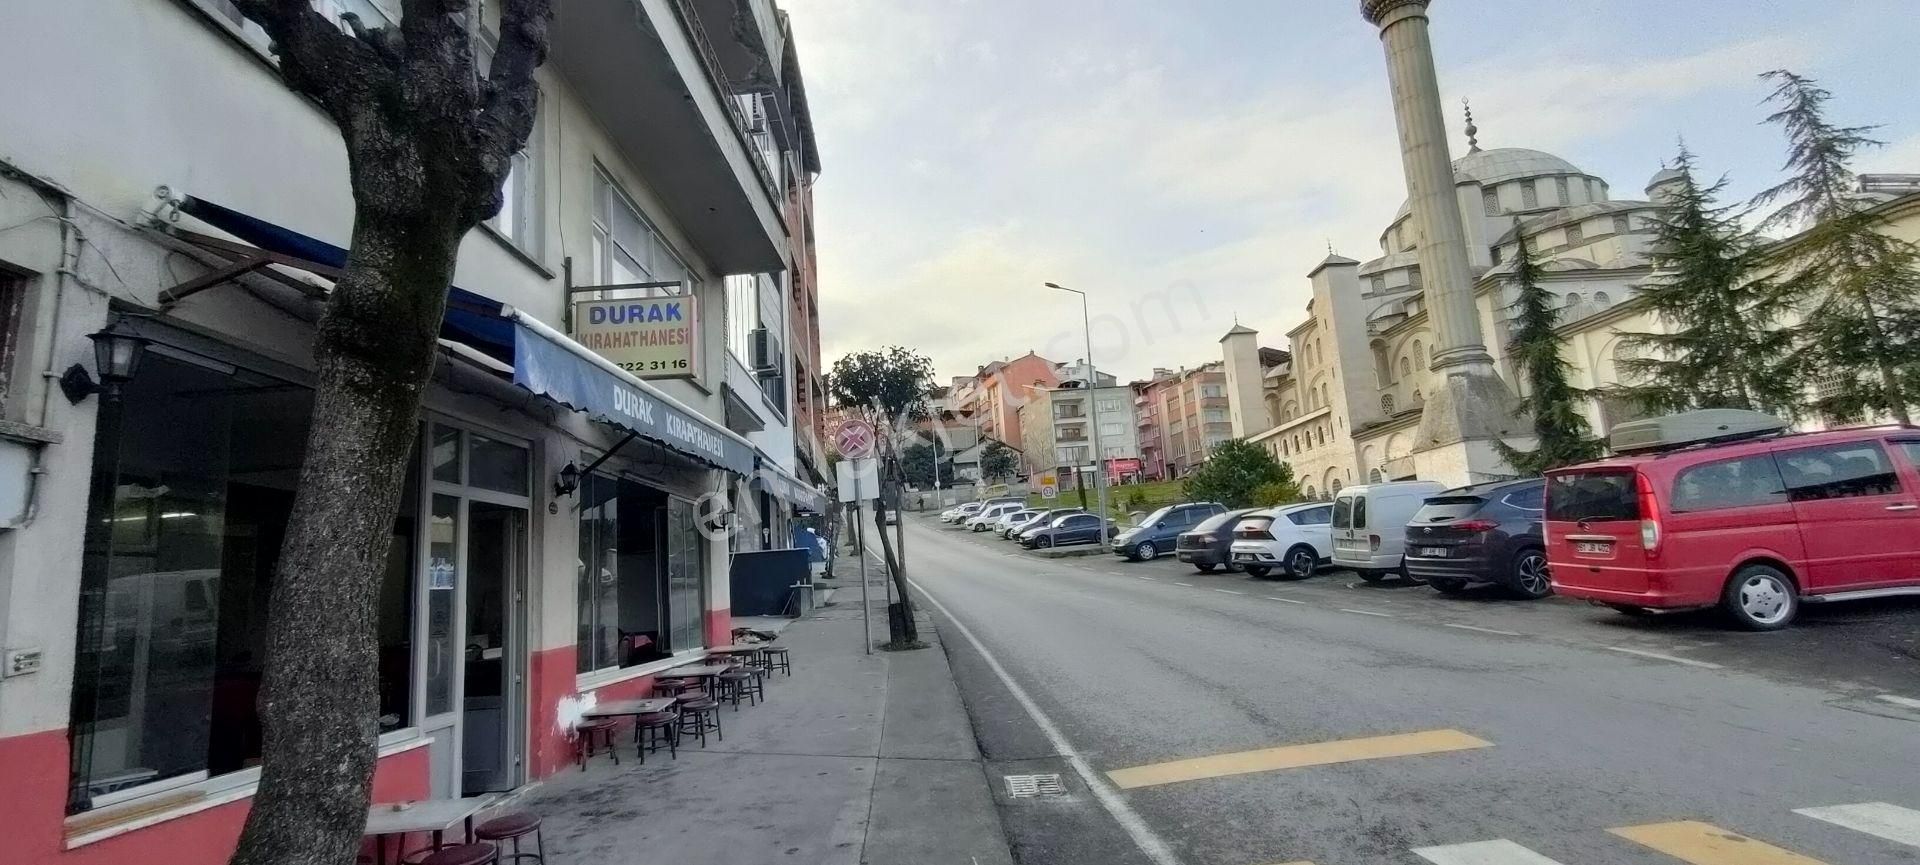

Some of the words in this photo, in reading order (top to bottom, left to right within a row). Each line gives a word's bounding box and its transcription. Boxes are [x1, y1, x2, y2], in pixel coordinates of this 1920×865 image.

[589, 302, 682, 325] DURAK
[650, 361, 666, 370] 31
[671, 359, 687, 369] 16
[613, 384, 654, 426] DURAK
